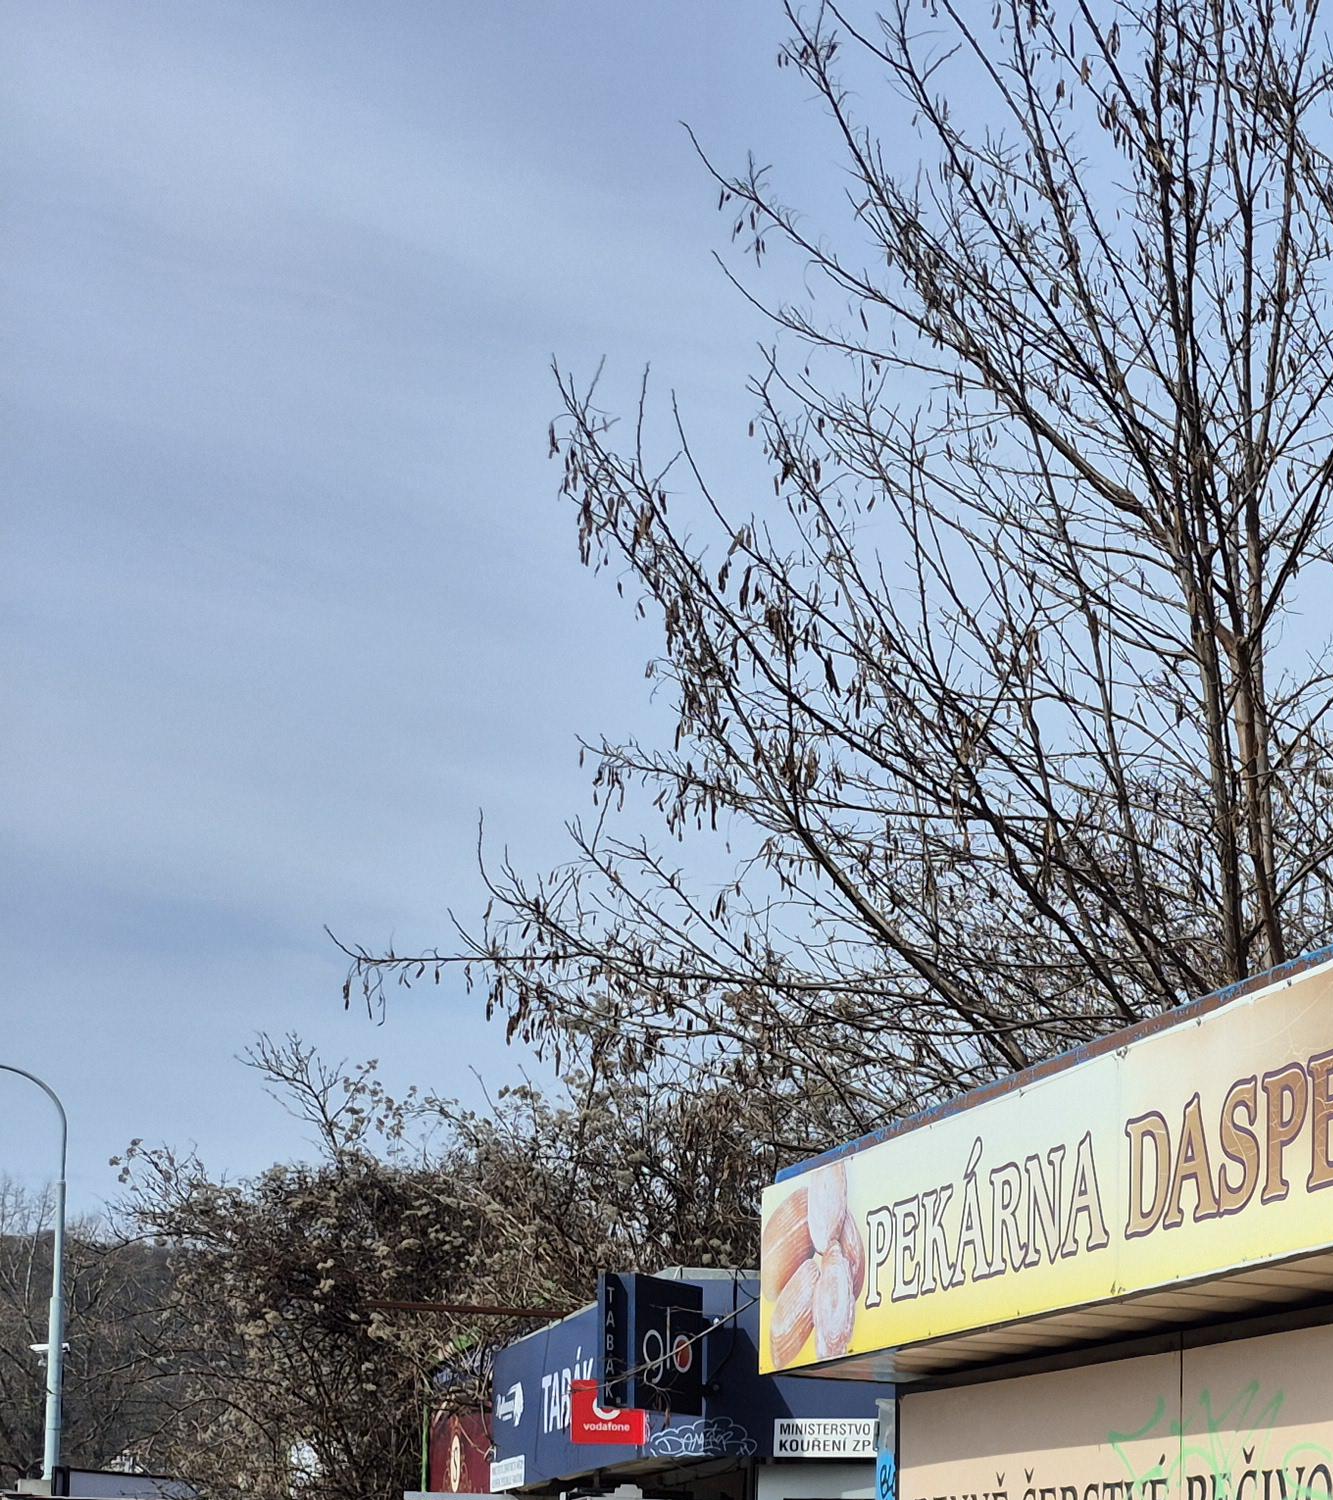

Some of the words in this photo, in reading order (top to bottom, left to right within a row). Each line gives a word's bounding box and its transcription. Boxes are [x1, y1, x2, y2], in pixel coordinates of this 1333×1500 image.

[864, 1136, 1110, 1309] PEKÁRNA
[642, 1306, 693, 1384] glo
[583, 1421, 631, 1432] vodafone
[779, 1423, 871, 1436] MINISTERSTVO
[779, 1438, 847, 1452] KOUŘENÍ
